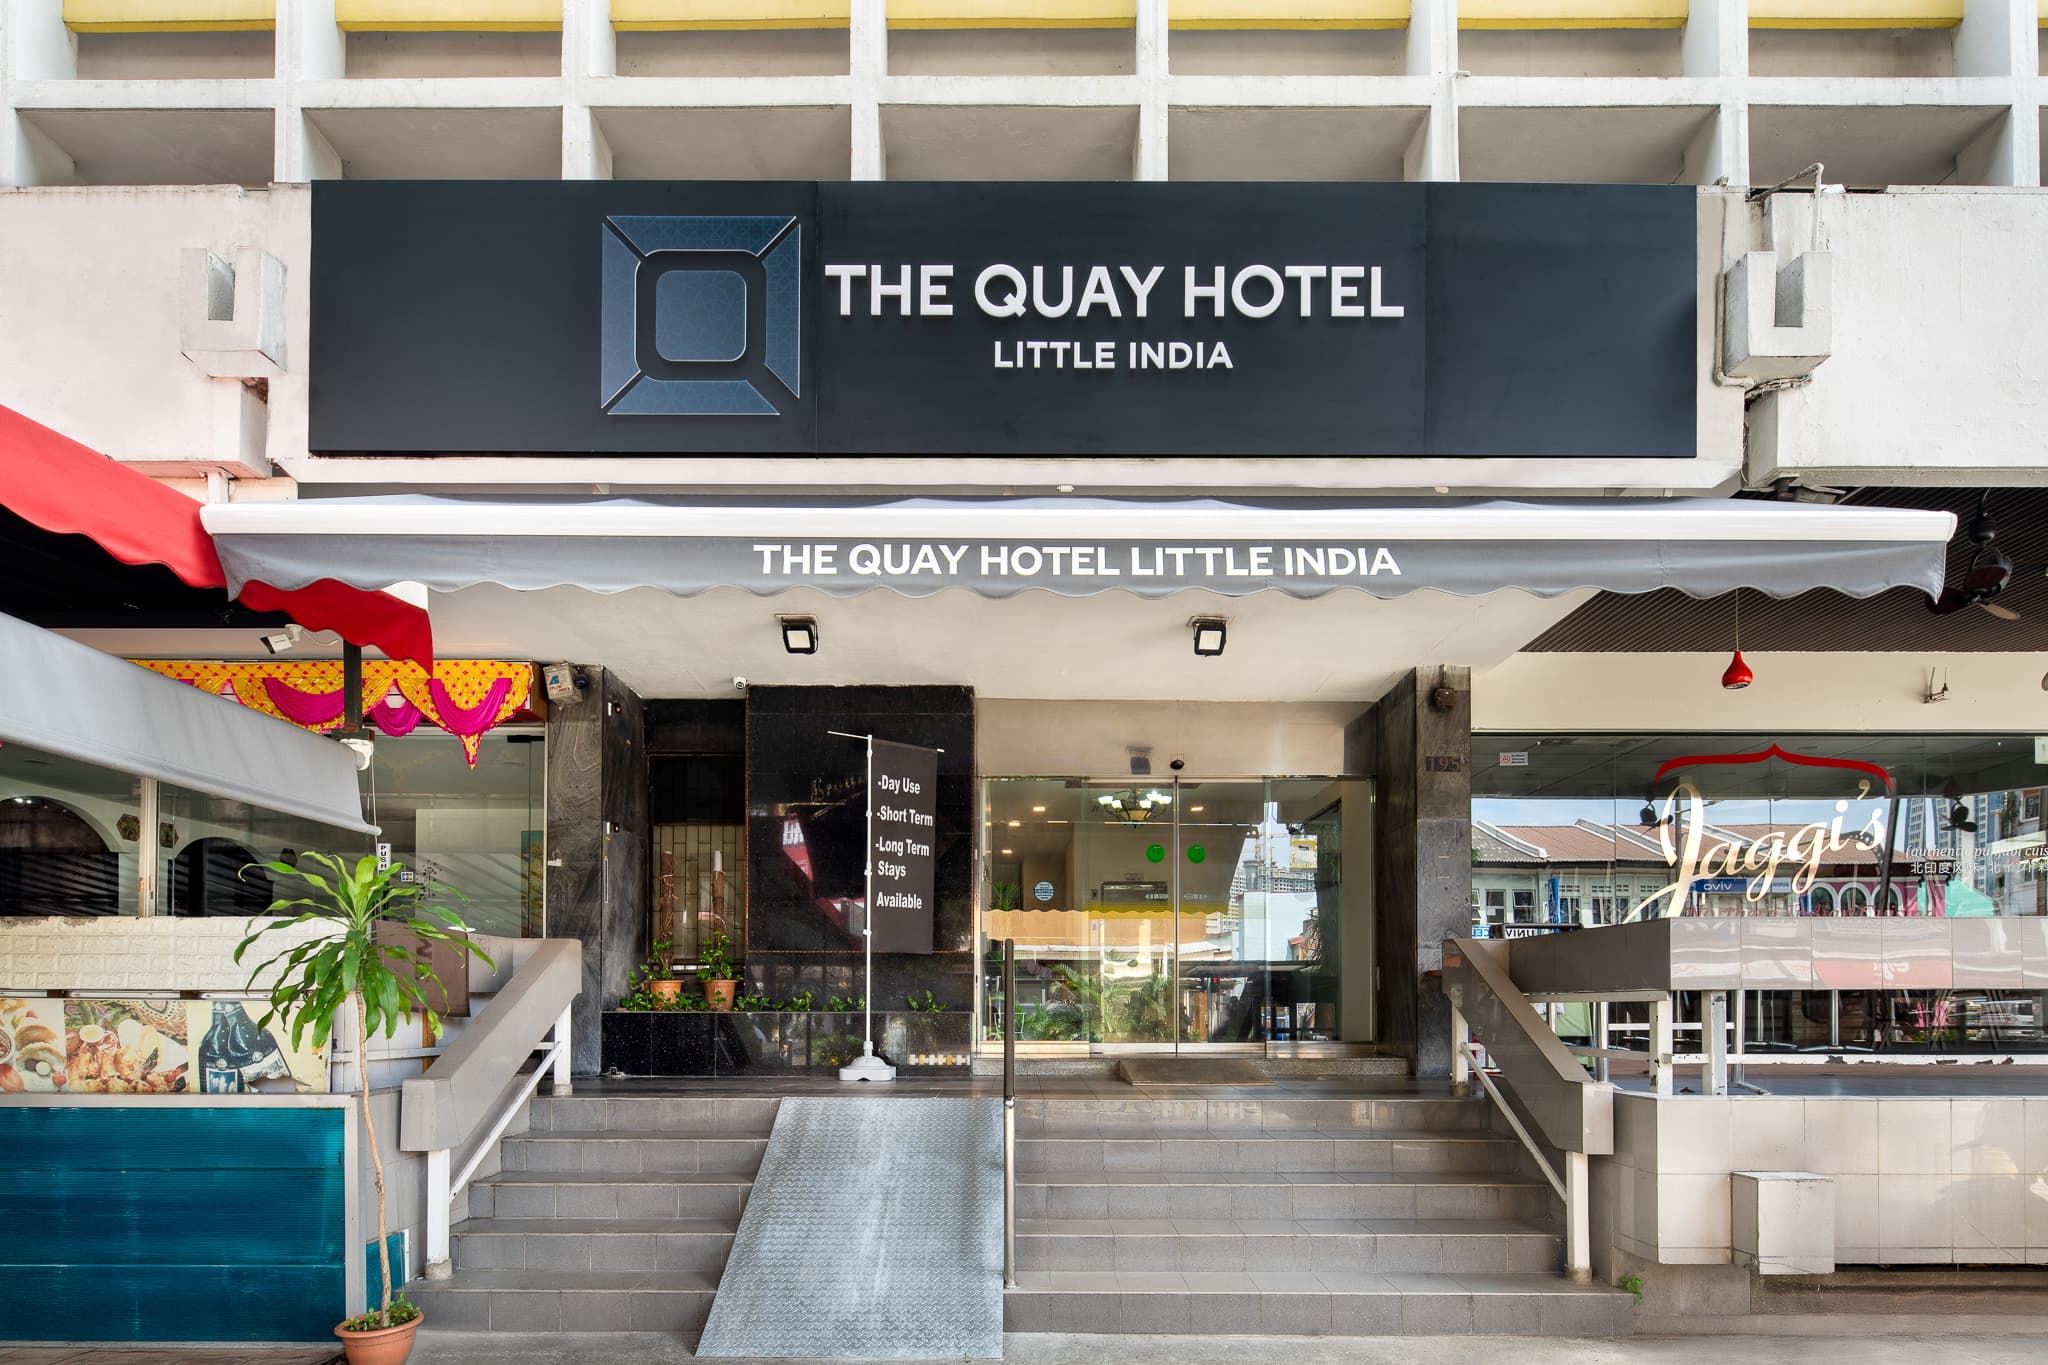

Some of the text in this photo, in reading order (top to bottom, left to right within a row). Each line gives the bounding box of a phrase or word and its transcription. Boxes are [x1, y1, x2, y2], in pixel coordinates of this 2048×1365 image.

[825, 264, 1404, 318] THE QUAY HOTEL
[994, 341, 1233, 369] LITTLE INDIA
[754, 544, 1401, 577] THE QUAY HOTEL LITTLE INDIA
[878, 774, 901, 795] -Day
[902, 777, 921, 795] Use
[876, 805, 933, 827] -Short Term
[875, 836, 930, 857] -Long Term
[1624, 779, 1886, 922] Jaggi's
[877, 860, 907, 881] Stays
[876, 891, 923, 910] Available
